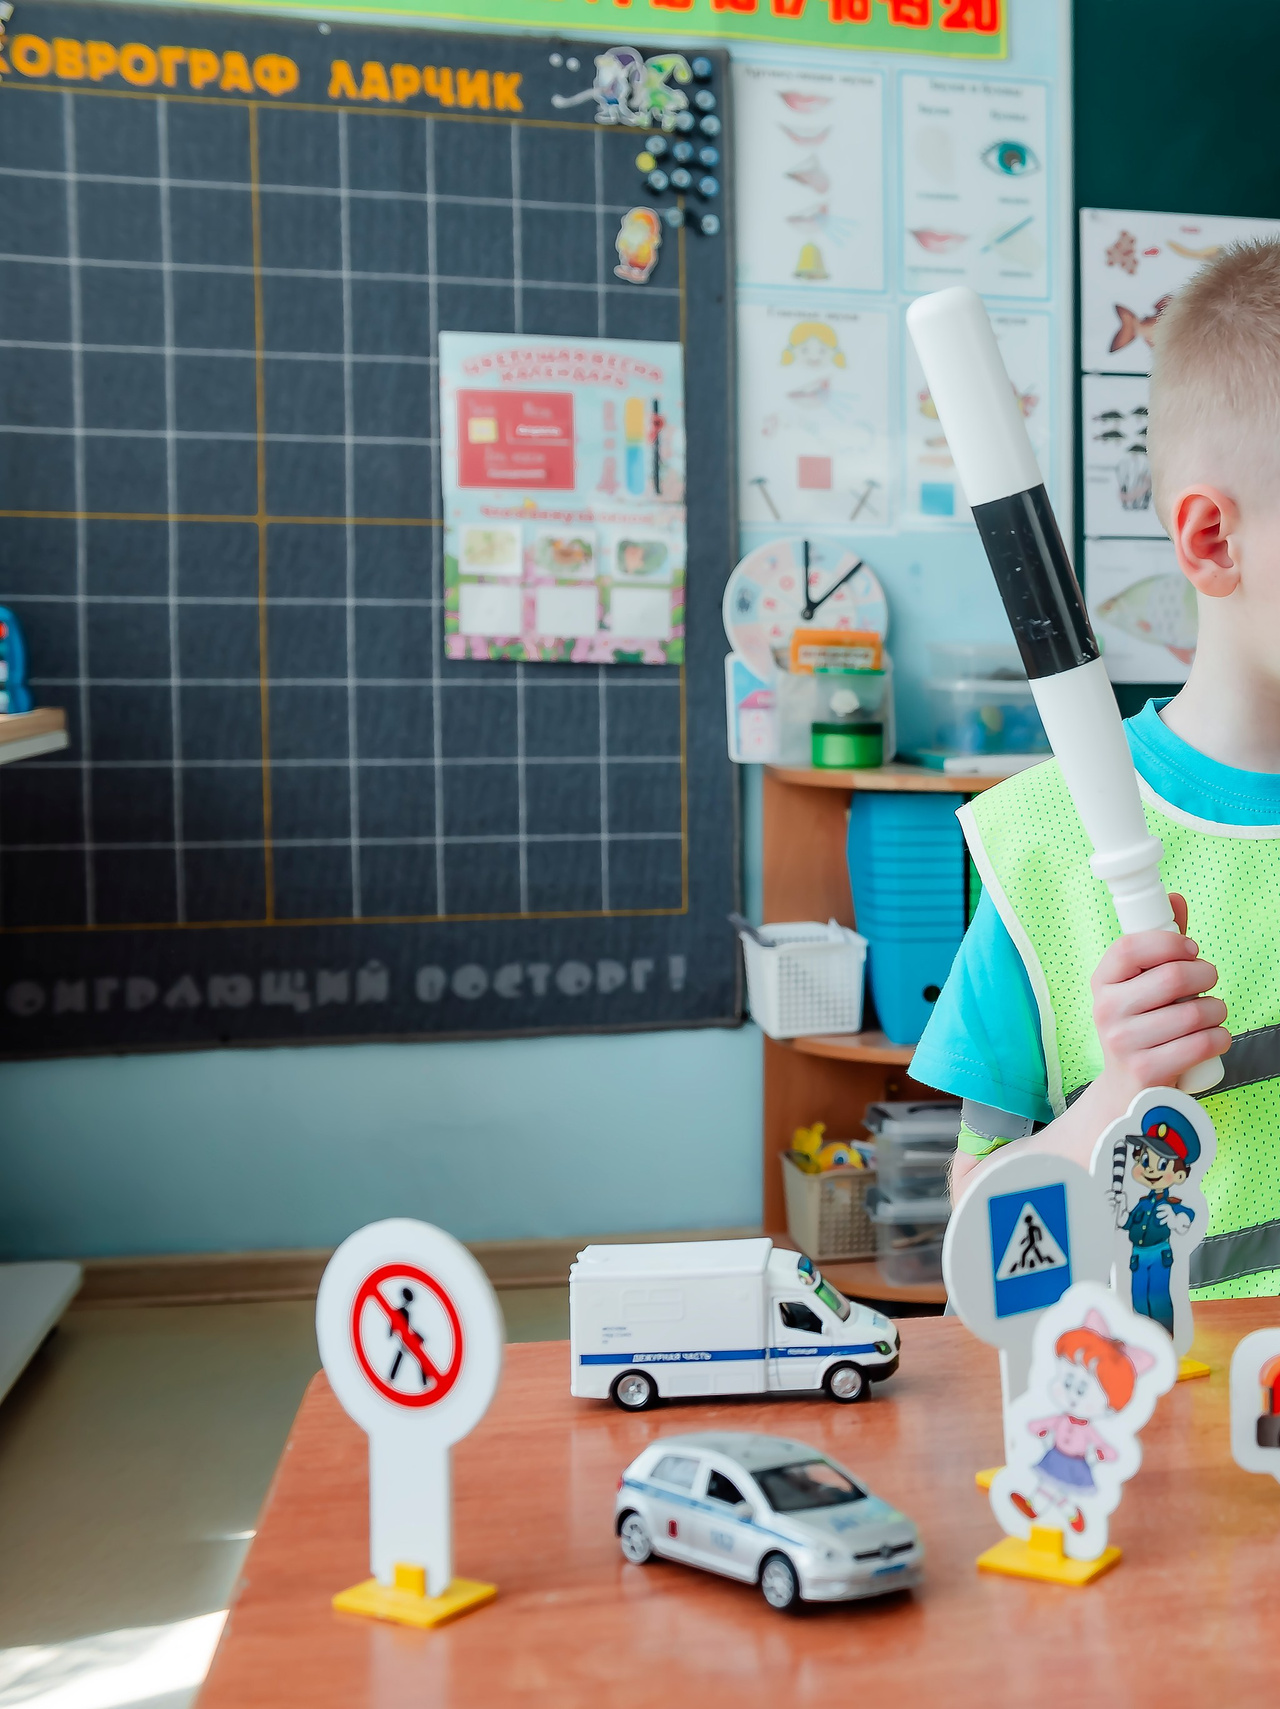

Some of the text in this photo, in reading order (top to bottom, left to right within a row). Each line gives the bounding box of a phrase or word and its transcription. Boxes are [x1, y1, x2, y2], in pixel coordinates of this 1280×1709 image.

[938, 0, 1000, 35] 20
[328, 59, 524, 112] ЛАРЧИК
[681, 1351, 712, 1361] ЧАСТЬ
